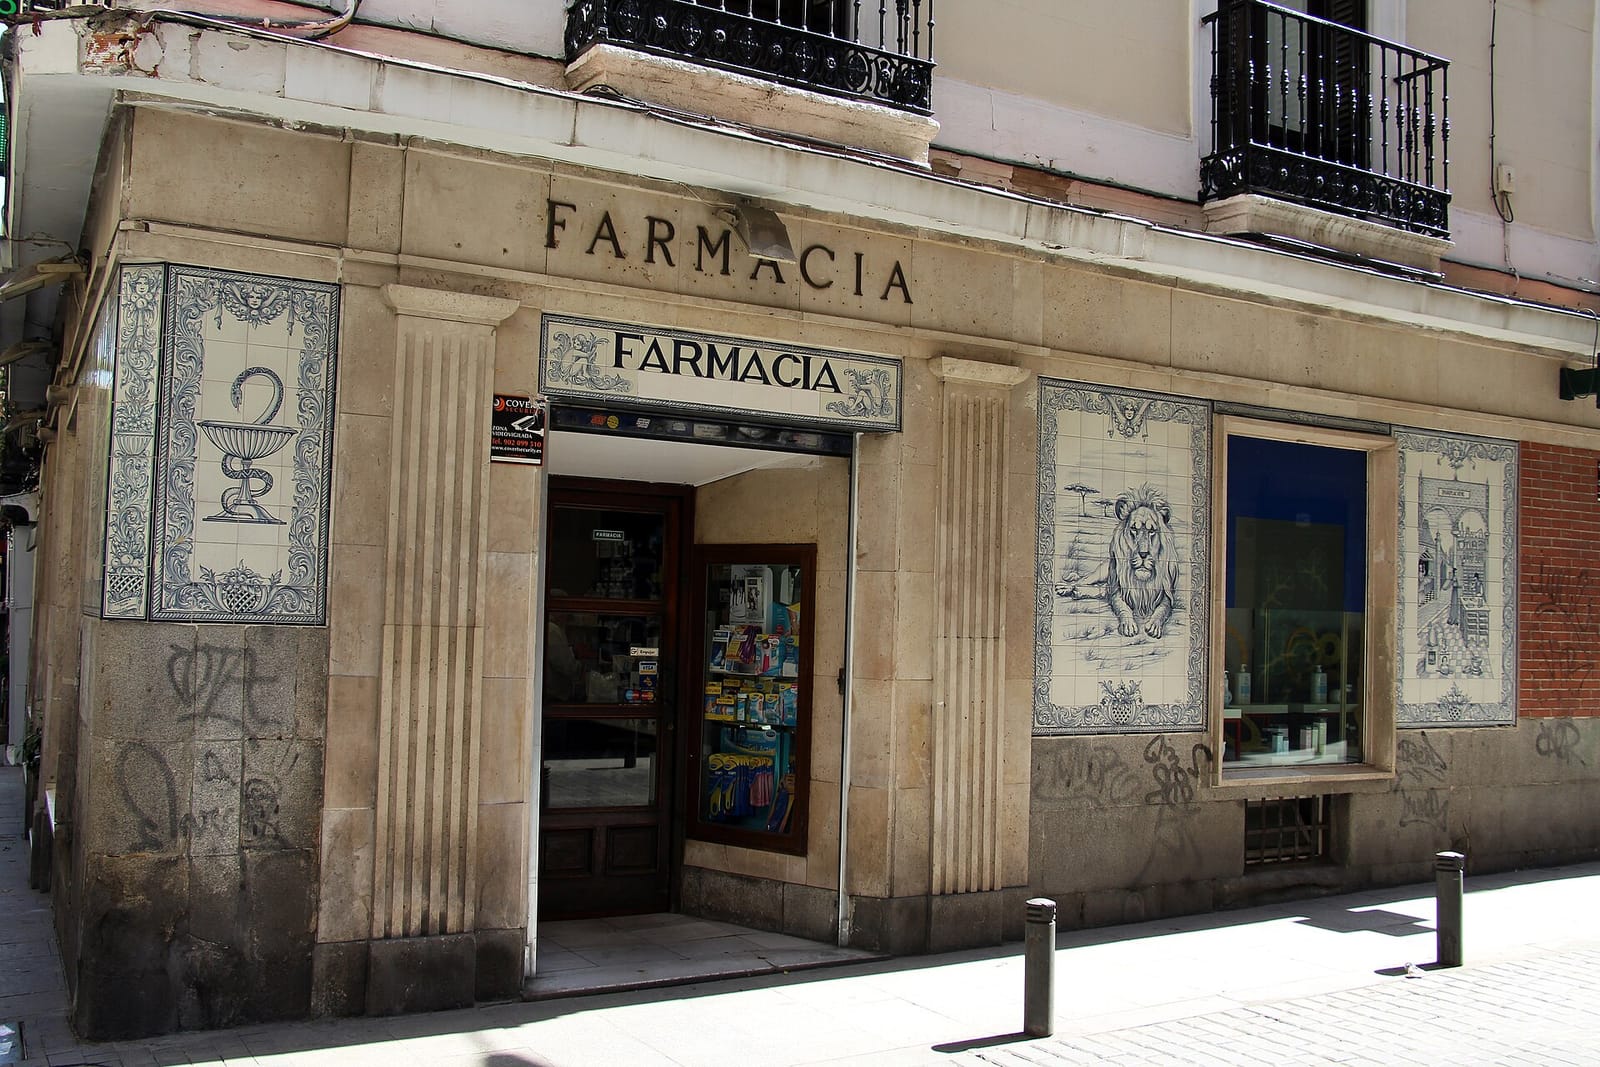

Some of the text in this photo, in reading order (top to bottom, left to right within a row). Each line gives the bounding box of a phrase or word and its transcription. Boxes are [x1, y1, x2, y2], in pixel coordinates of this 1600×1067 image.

[544, 198, 914, 304] FARMACIA
[613, 332, 842, 394] FARMACIA
[492, 431, 533, 439] VIDEOVIGILADA
